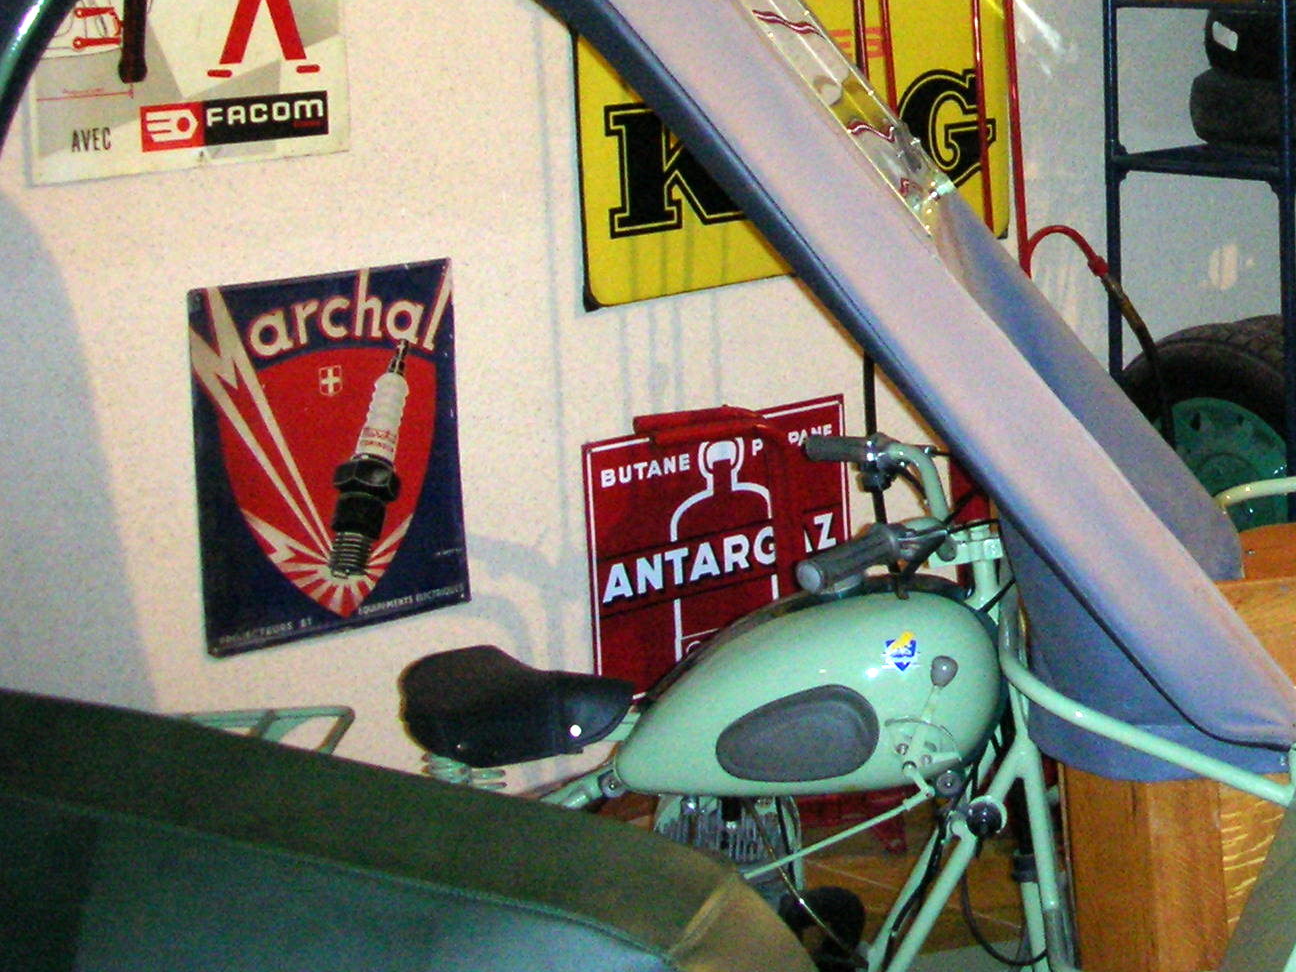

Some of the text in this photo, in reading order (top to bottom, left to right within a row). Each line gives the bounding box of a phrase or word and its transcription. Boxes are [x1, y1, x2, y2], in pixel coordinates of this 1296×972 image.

[206, 98, 325, 128] FACOM
[71, 126, 113, 153] AVEC
[600, 453, 691, 489] BUTANE
[602, 512, 838, 604] ANTARGZ
